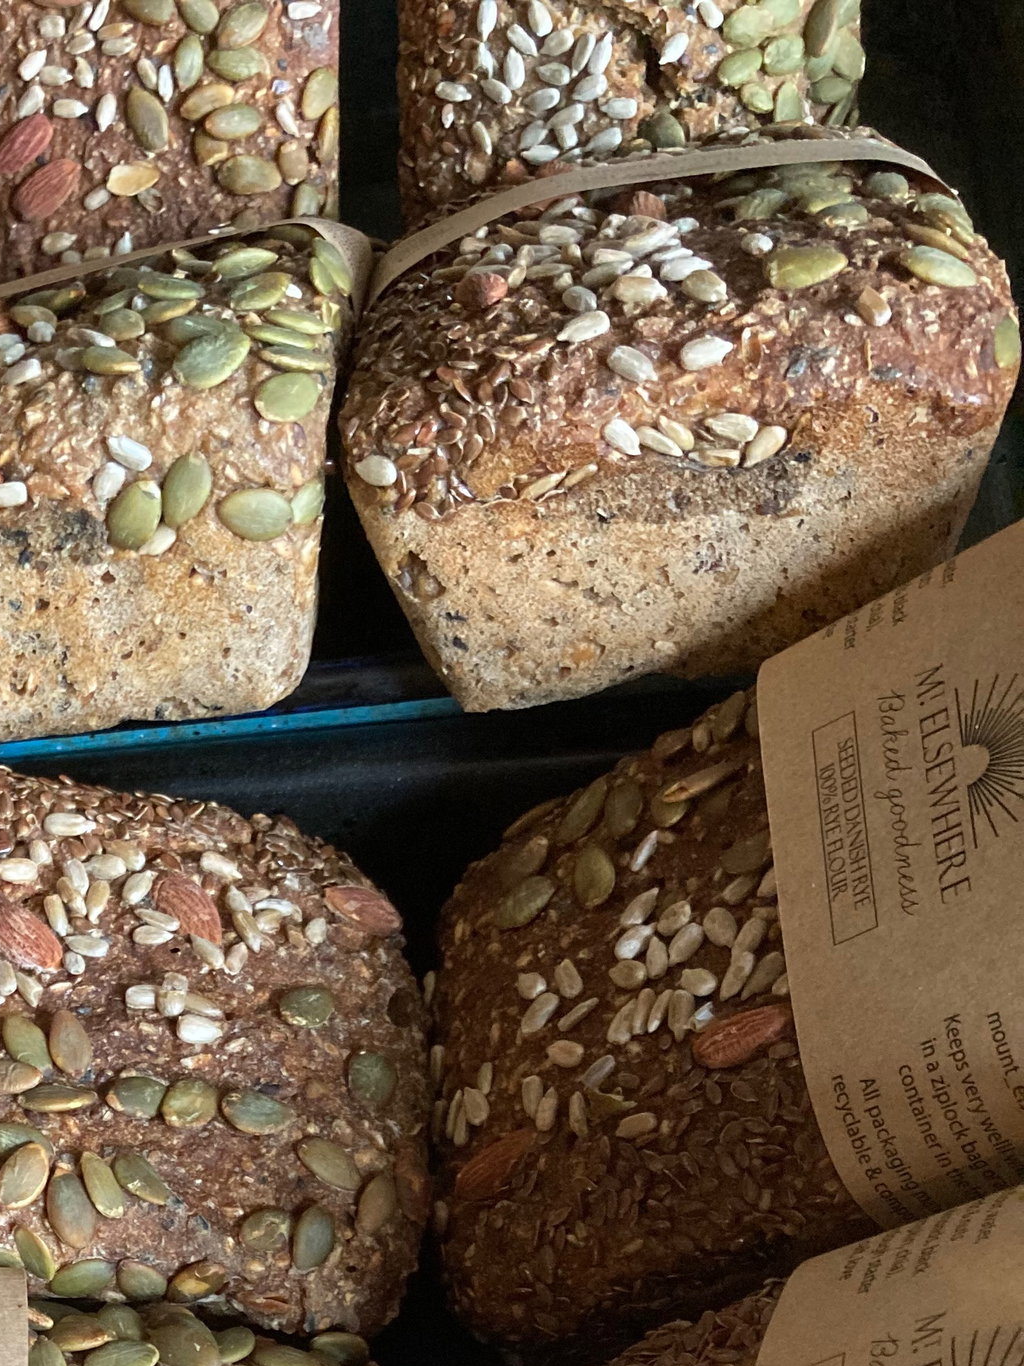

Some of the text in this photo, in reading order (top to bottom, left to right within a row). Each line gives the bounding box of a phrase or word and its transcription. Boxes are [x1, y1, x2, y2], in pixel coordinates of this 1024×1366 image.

[819, 762, 849, 903] 100% RYE FLOUR
[837, 737, 872, 911] SEEDED DANISH RYE
[873, 689, 922, 917] Baked goodness
[919, 706, 972, 905] ELSEWHERE
[859, 1078, 881, 1102] All
[919, 1037, 937, 1058] in
[926, 1060, 939, 1072] a
[943, 1013, 985, 1115] Keeps very
[831, 1073, 882, 1182] recyclable &
[865, 1103, 919, 1195] packaging
[898, 1064, 943, 1150] container
[934, 1151, 953, 1169] in
[930, 1075, 971, 1141] ziplock
[960, 1140, 987, 1172] bag
